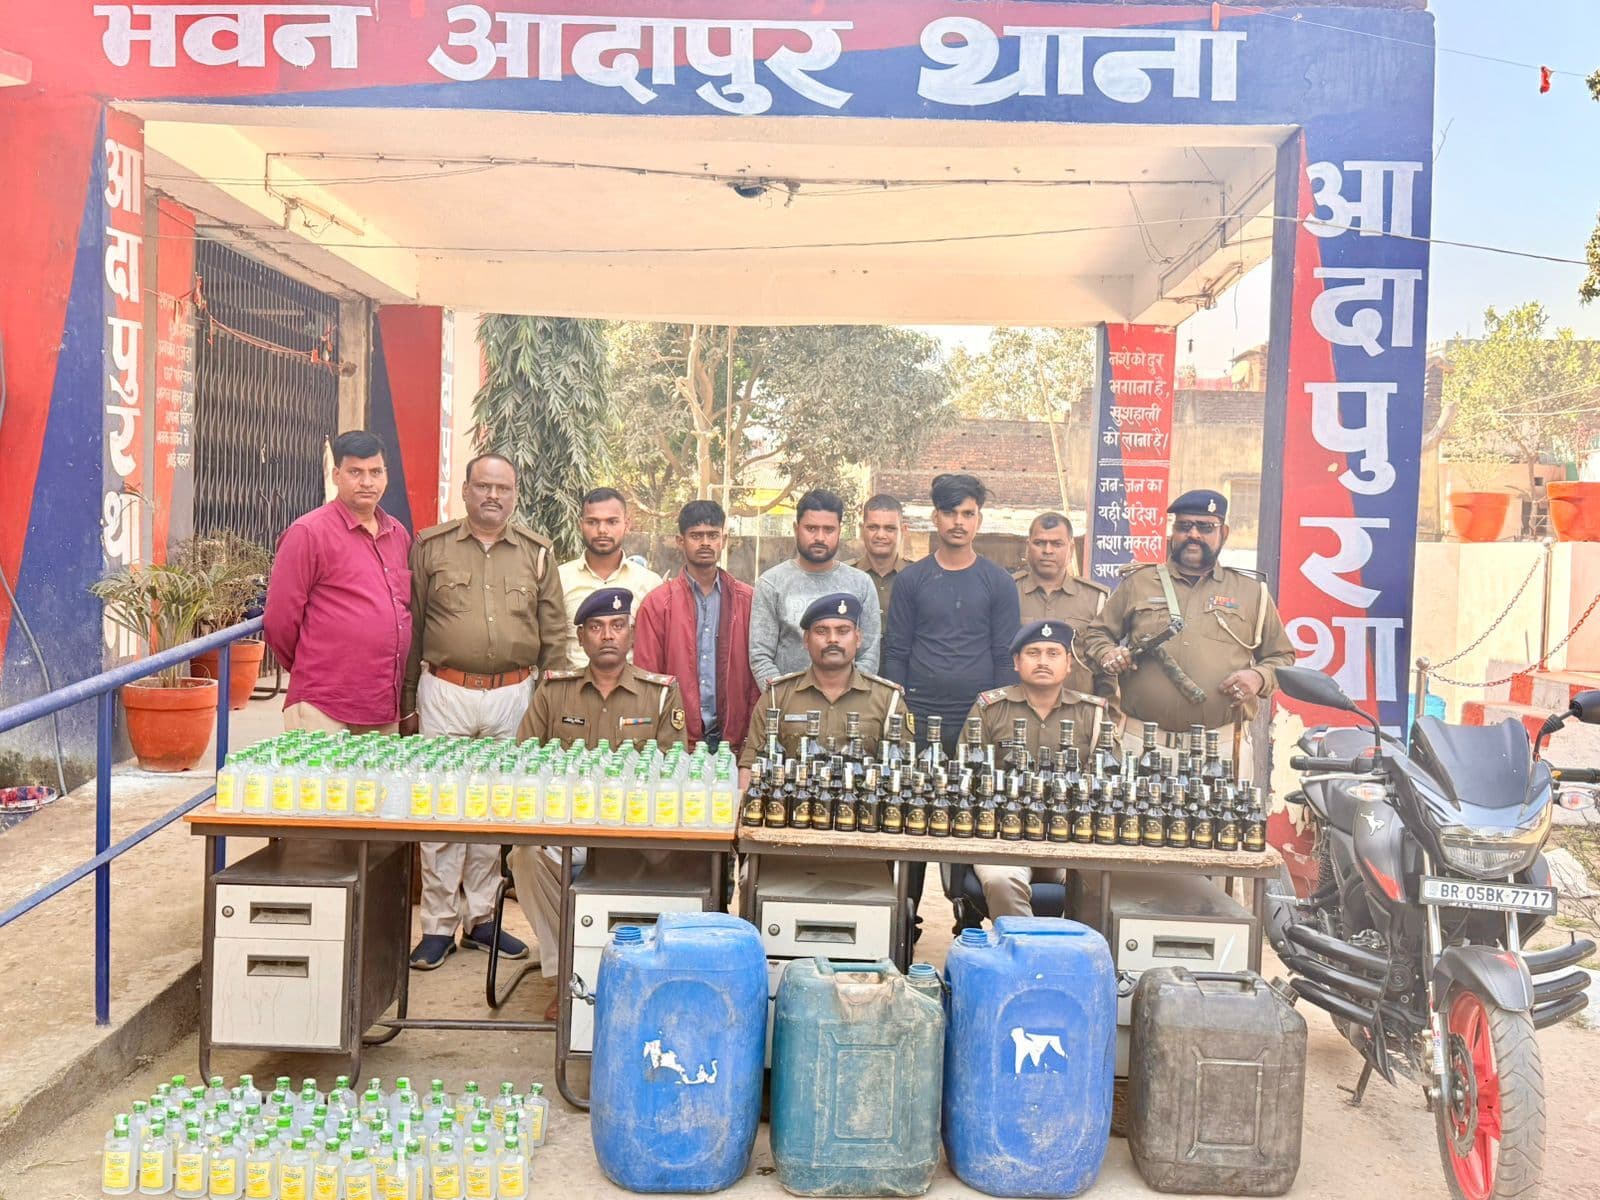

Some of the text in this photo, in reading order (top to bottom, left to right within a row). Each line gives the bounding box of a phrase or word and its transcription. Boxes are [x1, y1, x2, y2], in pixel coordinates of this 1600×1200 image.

[93, 4, 1247, 115] भवन आदापुर थाना
[104, 138, 143, 477] आदापुर
[1108, 379, 1154, 396] भगाना
[1299, 160, 1423, 609] आदापुर
[1109, 403, 1162, 427] खुशहाली
[1103, 426, 1120, 446] को
[1121, 432, 1153, 452] लाना
[1146, 479, 1164, 493] का
[1096, 535, 1123, 555] नशा
[1440, 883, 1550, 907] BR 05BK 7717
